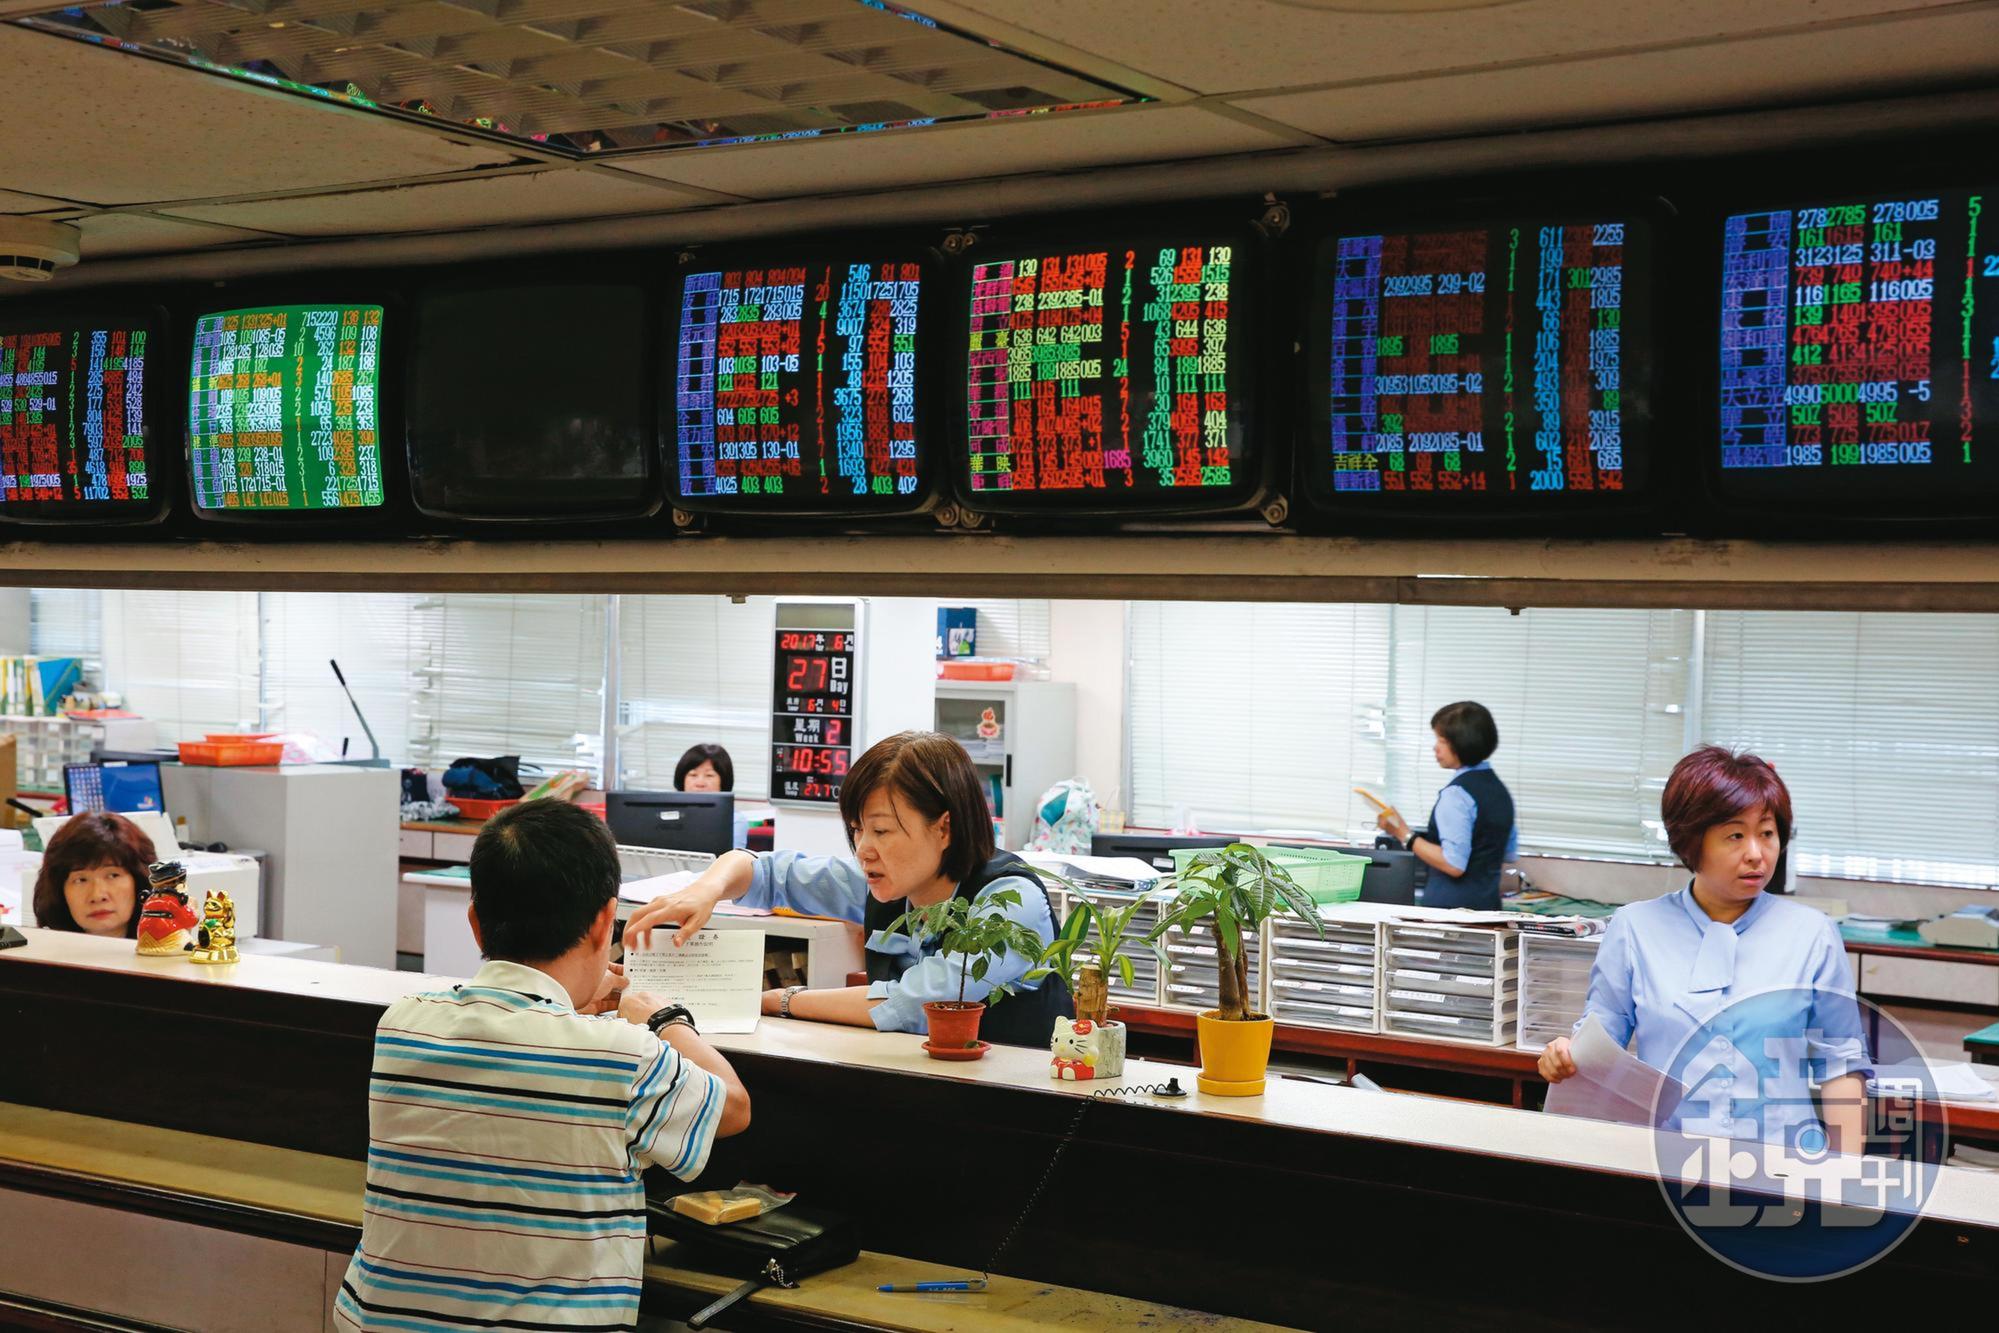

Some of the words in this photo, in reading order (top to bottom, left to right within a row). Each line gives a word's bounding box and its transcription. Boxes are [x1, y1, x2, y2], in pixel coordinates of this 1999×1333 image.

[1797, 208, 1827, 229] 278
[1826, 205, 1867, 227] 2785
[1872, 203, 1906, 224] 278
[1904, 199, 1940, 221] 005
[1967, 196, 1983, 217] 5
[1539, 226, 1563, 248] 611
[1592, 223, 1624, 246] 2255
[1798, 228, 1825, 248] 161
[1873, 222, 1903, 243] 161
[1019, 259, 1037, 277] 130
[1125, 251, 1135, 269] 2
[1159, 249, 1176, 267] 69
[1208, 247, 1231, 265] 130
[1824, 244, 1863, 265] 3125
[1870, 242, 1903, 262] 311
[1902, 239, 1936, 260] -03
[848, 264, 870, 282] 546
[1150, 267, 1174, 285] 526
[1200, 265, 1229, 283] 1515
[1015, 294, 1034, 311] 238
[1082, 288, 1103, 306] -01
[1170, 284, 1201, 302] 2395
[1204, 283, 1228, 301] 238
[1590, 287, 1621, 309] 1805
[1795, 286, 1824, 306] 116
[1822, 283, 1862, 304] 1165
[1870, 280, 1901, 302] 116
[1900, 278, 1934, 300] 005
[1142, 303, 1171, 321] 1068
[836, 318, 865, 336] 9007
[894, 317, 916, 335] 319
[1013, 329, 1033, 346] 636
[1036, 327, 1056, 344] 642
[1060, 326, 1081, 343] 642
[1081, 324, 1102, 342] 003
[1155, 321, 1171, 339] 43
[1175, 320, 1198, 338] 644
[1203, 319, 1227, 338] 636
[848, 335, 864, 353] 97
[893, 334, 915, 352] 551
[718, 357, 735, 374] 103
[734, 356, 758, 374] 1035
[761, 355, 779, 373] 103
[842, 353, 863, 371] 155
[894, 353, 915, 370] 103
[1792, 344, 1822, 365] 412
[847, 371, 862, 388] 48
[887, 370, 914, 387] 1205
[834, 388, 862, 406] 3675
[1783, 384, 1821, 406] 4990
[1821, 382, 1859, 405] 5000
[1857, 381, 1899, 403] 4995
[1908, 380, 1931, 401] -5
[717, 408, 734, 425] 604
[737, 408, 756, 424] 605
[760, 407, 779, 424] 605
[841, 406, 862, 423] 323
[893, 405, 914, 422] 602
[1148, 412, 1171, 430] 379
[1204, 410, 1227, 429] 404
[1588, 410, 1620, 430] 3915
[1792, 405, 1822, 425] 507
[1866, 402, 1898, 423] 507
[836, 423, 863, 440] 1956
[1104, 450, 1131, 469] 1685
[1142, 449, 1173, 468] 3960
[1333, 453, 1378, 471] 吉祥全
[1785, 444, 1822, 466] 1985
[1830, 443, 1859, 465] 199
[1858, 442, 1899, 464] 1985
[1899, 442, 1932, 463] 005
[839, 459, 865, 476] 1693
[1158, 467, 1175, 486] 35
[1200, 466, 1231, 485] 2585
[715, 476, 738, 494] 4025
[741, 476, 760, 493] 403
[764, 476, 784, 493] 403
[852, 477, 867, 494] 28
[872, 476, 893, 494] 403
[898, 477, 917, 494] 402
[788, 657, 828, 690] 27
[831, 656, 847, 679] 日
[829, 679, 849, 695] Day
[825, 719, 842, 745] 2
[791, 748, 848, 776] 10:55
